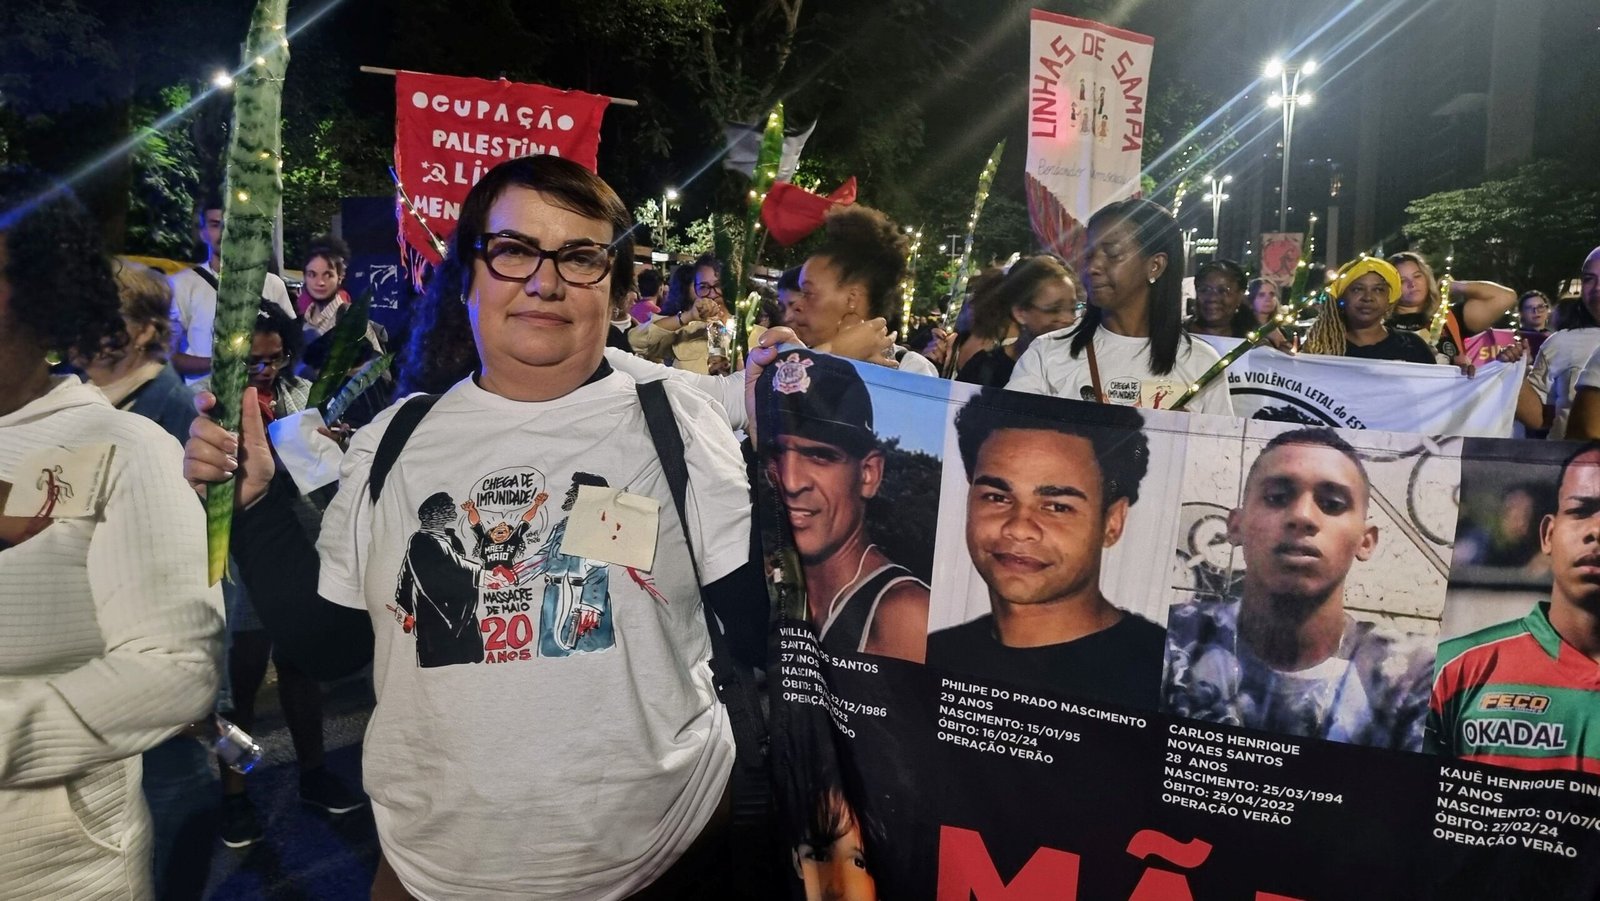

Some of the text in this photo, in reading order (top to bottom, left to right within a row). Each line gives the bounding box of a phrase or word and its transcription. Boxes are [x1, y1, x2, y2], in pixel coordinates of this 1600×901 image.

[1032, 32, 1143, 152] LINHAS DE SAMPA
[412, 91, 574, 131] OCUPAÇÃO
[413, 195, 460, 221] MEN
[1110, 382, 1138, 390] CHEGA DE
[1228, 372, 1241, 384] da
[1245, 372, 1301, 394] VIOLÊNCIA
[1305, 387, 1333, 411] LETAL
[1334, 405, 1347, 420] do
[482, 472, 535, 491] CHEGA DE
[476, 487, 537, 507] IMPUNIDADE!
[487, 552, 509, 562] MAIO
[507, 544, 516, 553] DE
[483, 588, 532, 604] MASSACRE
[486, 602, 530, 616] DE MAIO
[481, 614, 533, 651] 20
[485, 649, 532, 664] ANOS
[781, 653, 794, 662] 37
[832, 657, 879, 674] SANTOS
[940, 692, 994, 711] 29 ANOS
[942, 678, 1147, 728] PHILIPE DO PRADO NASCIMENTO
[938, 716, 1038, 747] ÓBITO: 16/02/24
[939, 705, 1081, 743] NASCIMENTO: 15/01/95
[1464, 719, 1566, 749] OKADAL
[936, 731, 1054, 764] OPERAÇÃO VERÃO
[1167, 738, 1284, 767] NOVAES SANTOS
[1169, 724, 1301, 756] CARLOS HENRIQUE
[1165, 752, 1228, 773] 28 ANOS
[1164, 766, 1343, 804] NASCIMENTO: 25/03/1994
[1440, 766, 1483, 784] KAUÊ
[1487, 775, 1565, 790] HENRIQUE
[1163, 778, 1295, 812] ÓBITO: 29/04/2022
[1438, 782, 1503, 804] 17 ANOS
[1161, 793, 1292, 825] OPERAÇÃO VERÃO
[1436, 797, 1541, 819] NASCIMENTO:
[1435, 810, 1559, 838] ÓBITO: 27/02/24
[1433, 827, 1578, 858] OPERAÇÃO VERÃO
